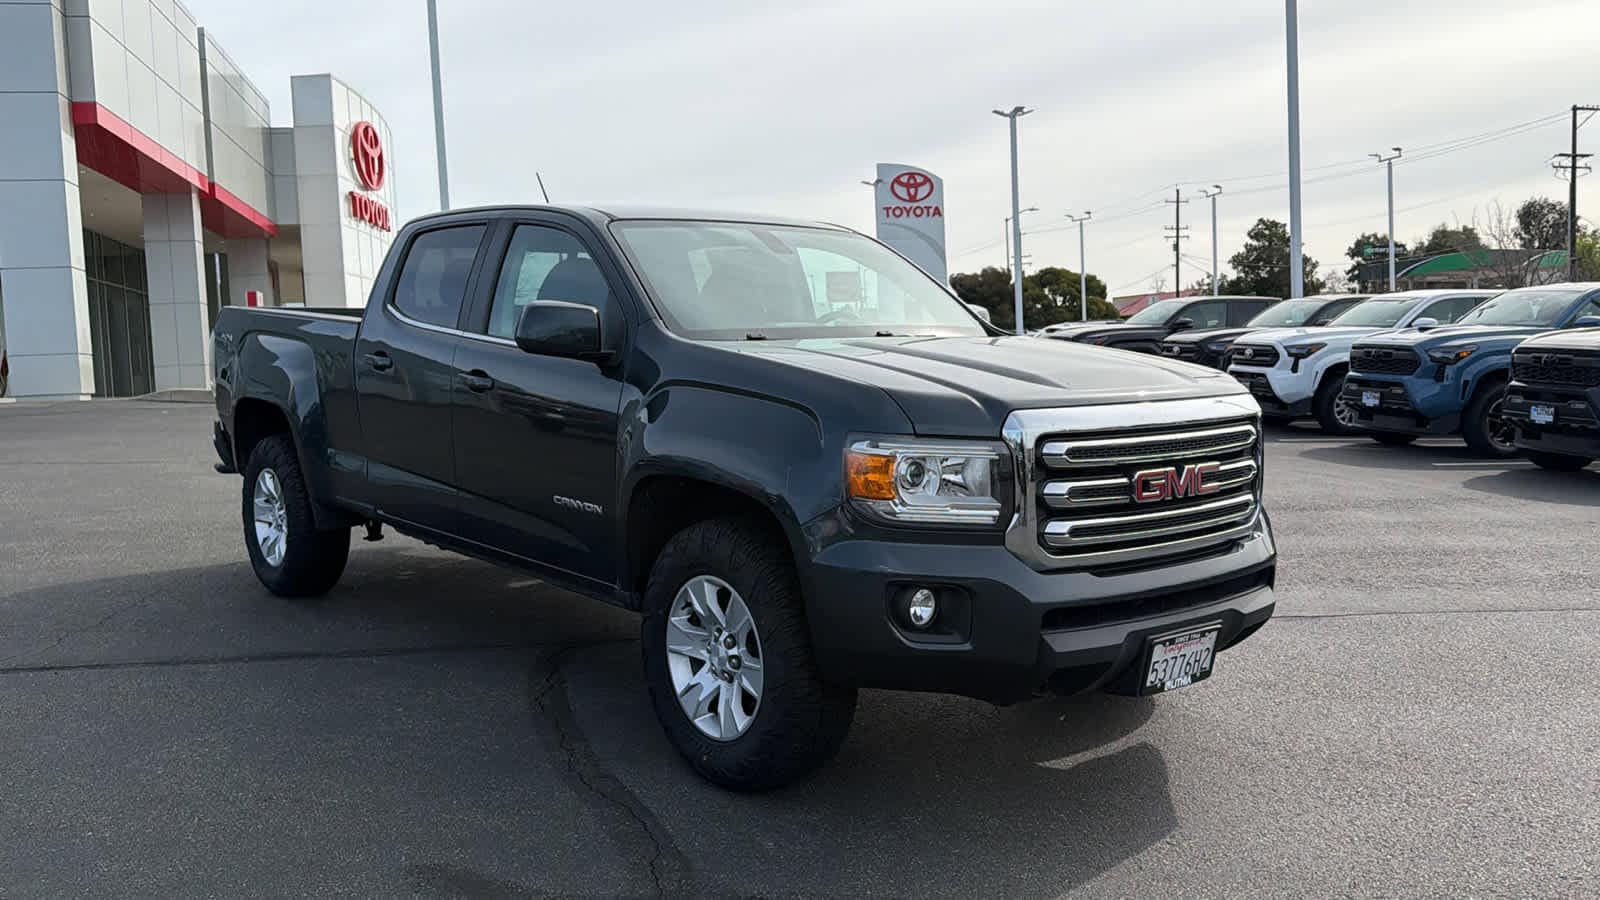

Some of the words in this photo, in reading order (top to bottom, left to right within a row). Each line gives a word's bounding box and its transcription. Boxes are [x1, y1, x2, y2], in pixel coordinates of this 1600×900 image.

[349, 191, 391, 232] TOYOTA
[882, 205, 942, 219] TOYOTA
[1132, 461, 1221, 503] GMC
[552, 495, 603, 514] CANYON
[1149, 647, 1211, 684] 53776H2
